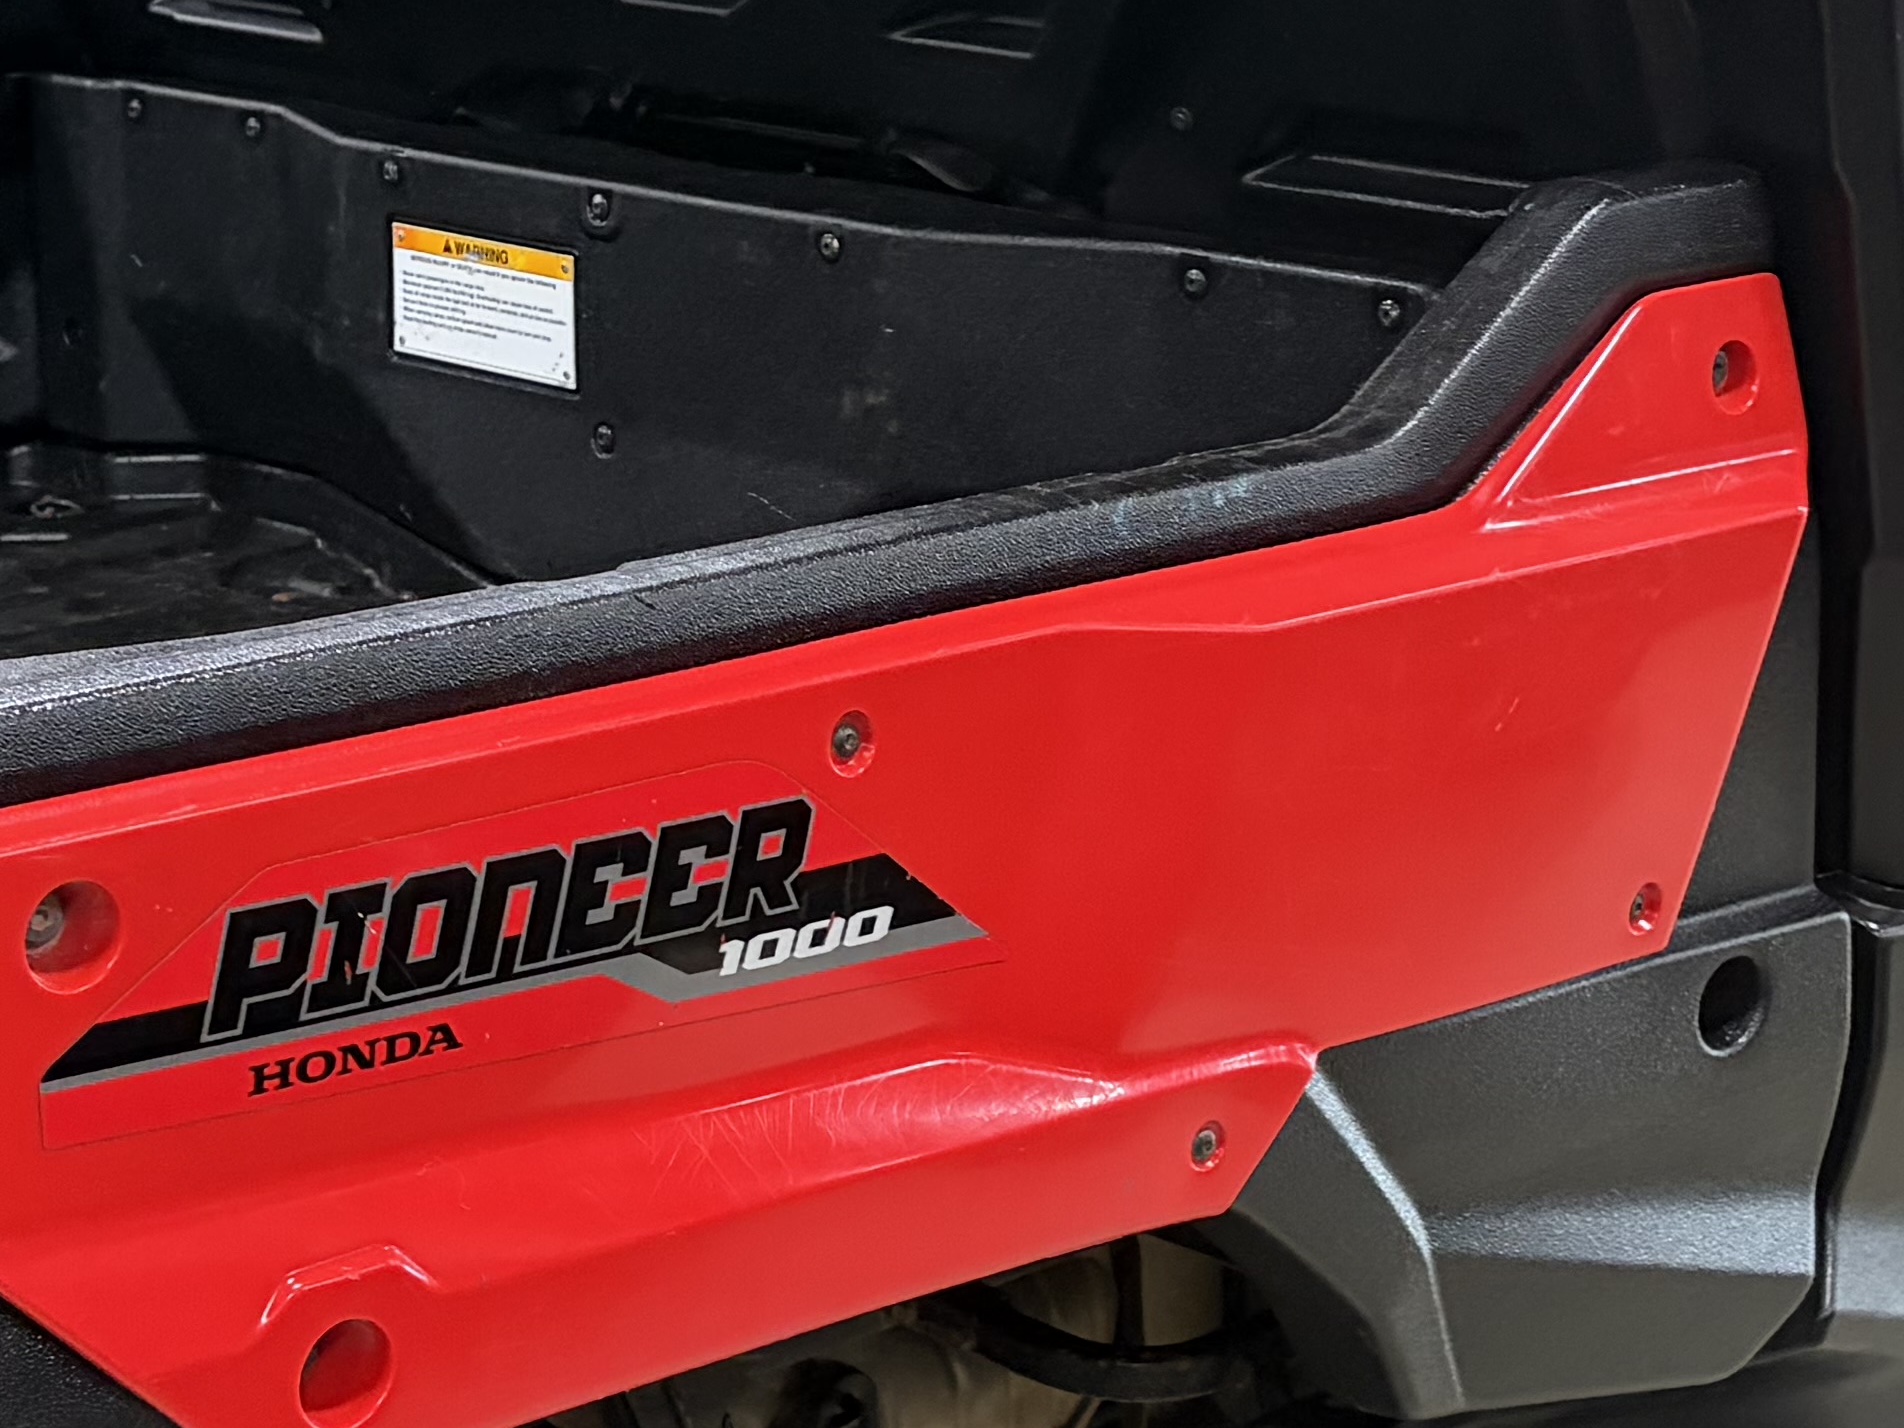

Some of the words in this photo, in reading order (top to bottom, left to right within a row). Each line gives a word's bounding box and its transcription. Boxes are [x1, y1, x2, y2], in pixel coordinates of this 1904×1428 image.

[455, 240, 508, 264] WARNING
[201, 797, 813, 1041] PIONEER
[717, 904, 895, 977] 1000
[246, 1022, 464, 1098] HONDA
